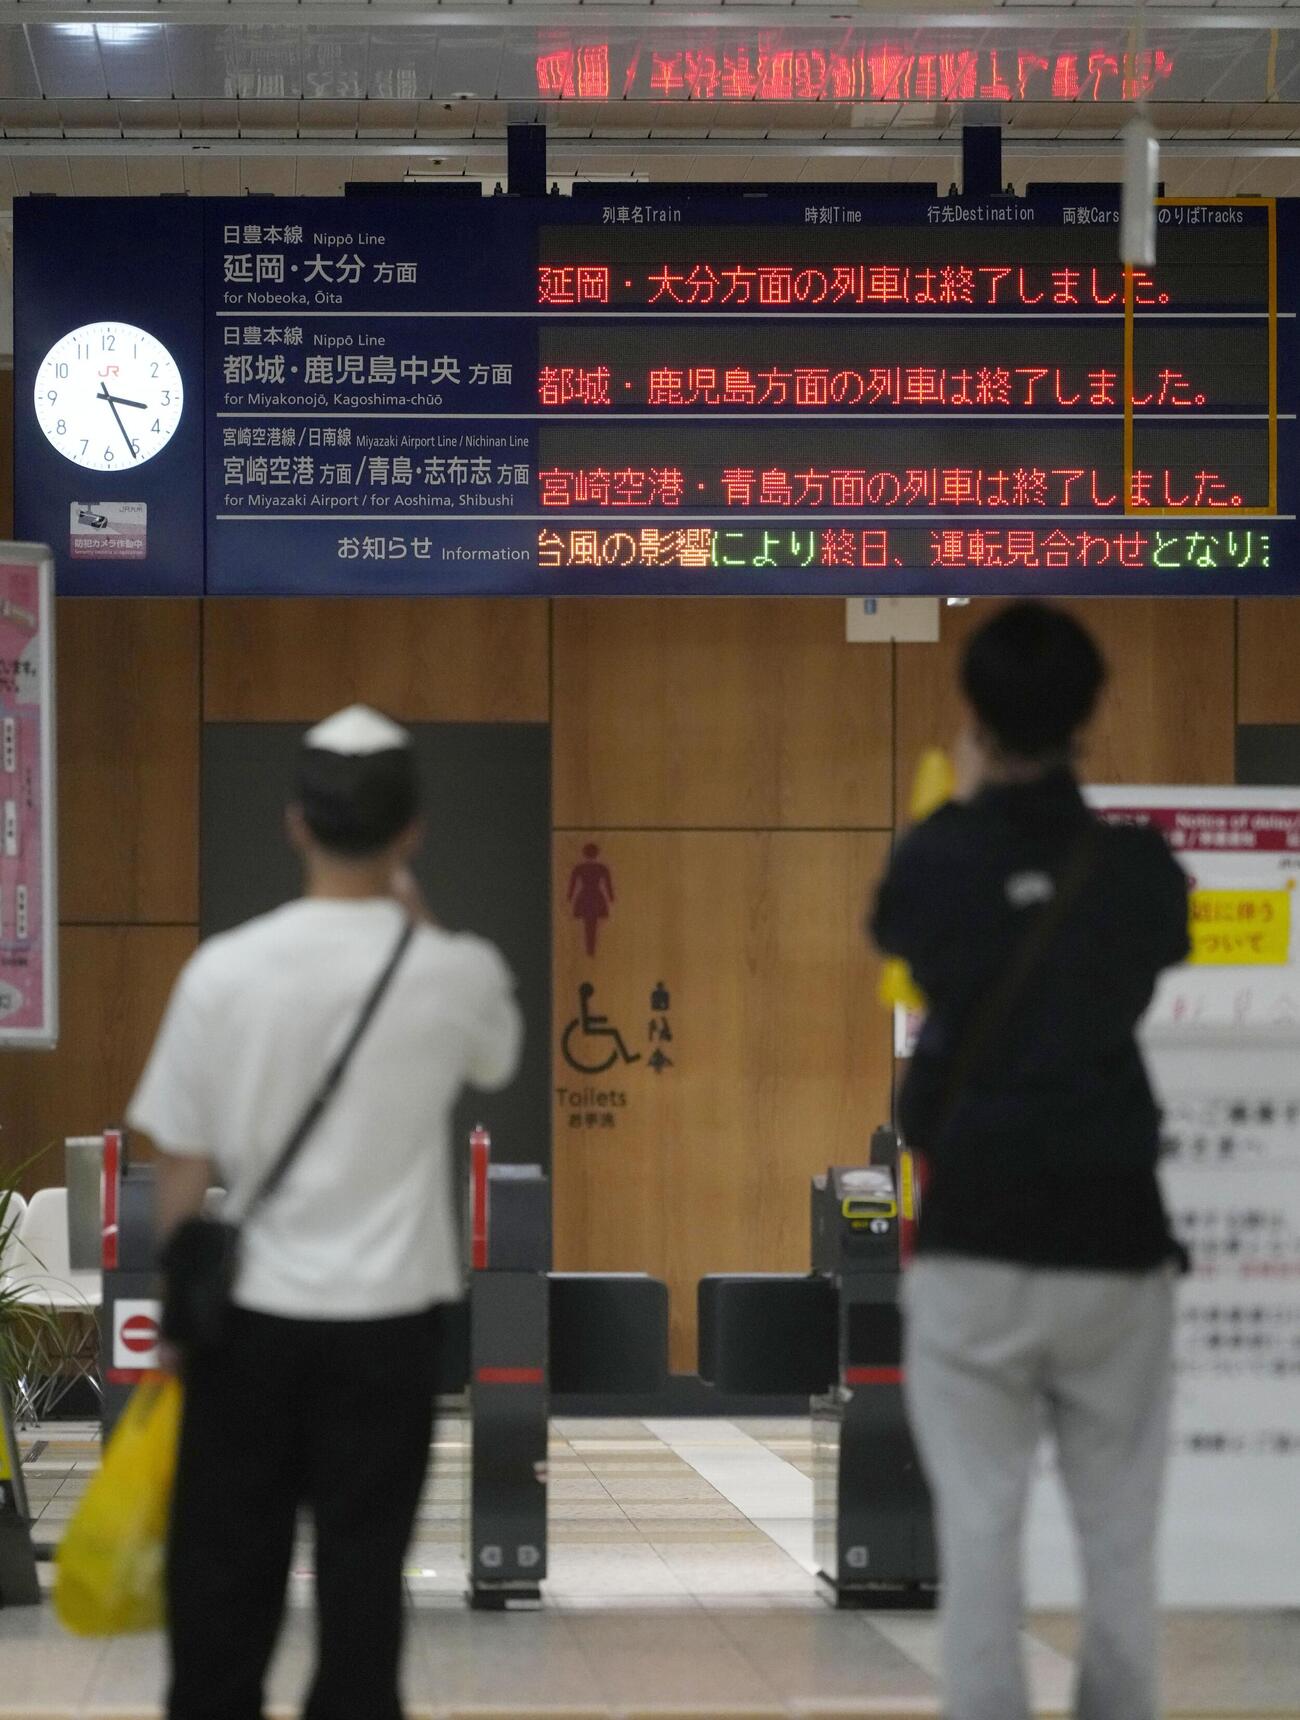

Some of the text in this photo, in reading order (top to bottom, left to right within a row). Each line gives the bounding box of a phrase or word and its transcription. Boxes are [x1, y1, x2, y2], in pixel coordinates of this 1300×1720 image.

[224, 225, 386, 247] 日豊本線 Nippō Line
[224, 290, 343, 305] for Nobeoka, Ōita
[102, 334, 116, 351] 12
[224, 326, 386, 348] 日豊本線 Nippō Line
[78, 344, 89, 359] 11
[55, 362, 69, 379] 10
[98, 366, 120, 377] JR
[150, 362, 159, 378] 2
[47, 390, 58, 406] 9
[161, 390, 171, 406] 3
[224, 392, 443, 408] for Miyakonojō, Kagoshima-chūō
[56, 419, 67, 436] 8
[151, 418, 161, 434] 4
[80, 439, 89, 456] 7
[132, 438, 140, 455] 5
[356, 435, 398, 449] Miyazaki
[400, 435, 435, 449] Airport
[437, 435, 457, 447] Line
[465, 435, 507, 447] Nichinan
[509, 435, 529, 447] Line
[103, 446, 114, 462] 6
[224, 494, 244, 506] for
[248, 494, 307, 508] Miyazaki
[311, 494, 359, 509] Airport
[370, 494, 391, 506] for
[394, 494, 455, 508] Aoshima,
[458, 494, 514, 507] Shibushi
[337, 536, 530, 561] お知らせ Information
[538, 528, 1269, 568] 台風の影響により終日、運転見合わせとなり
